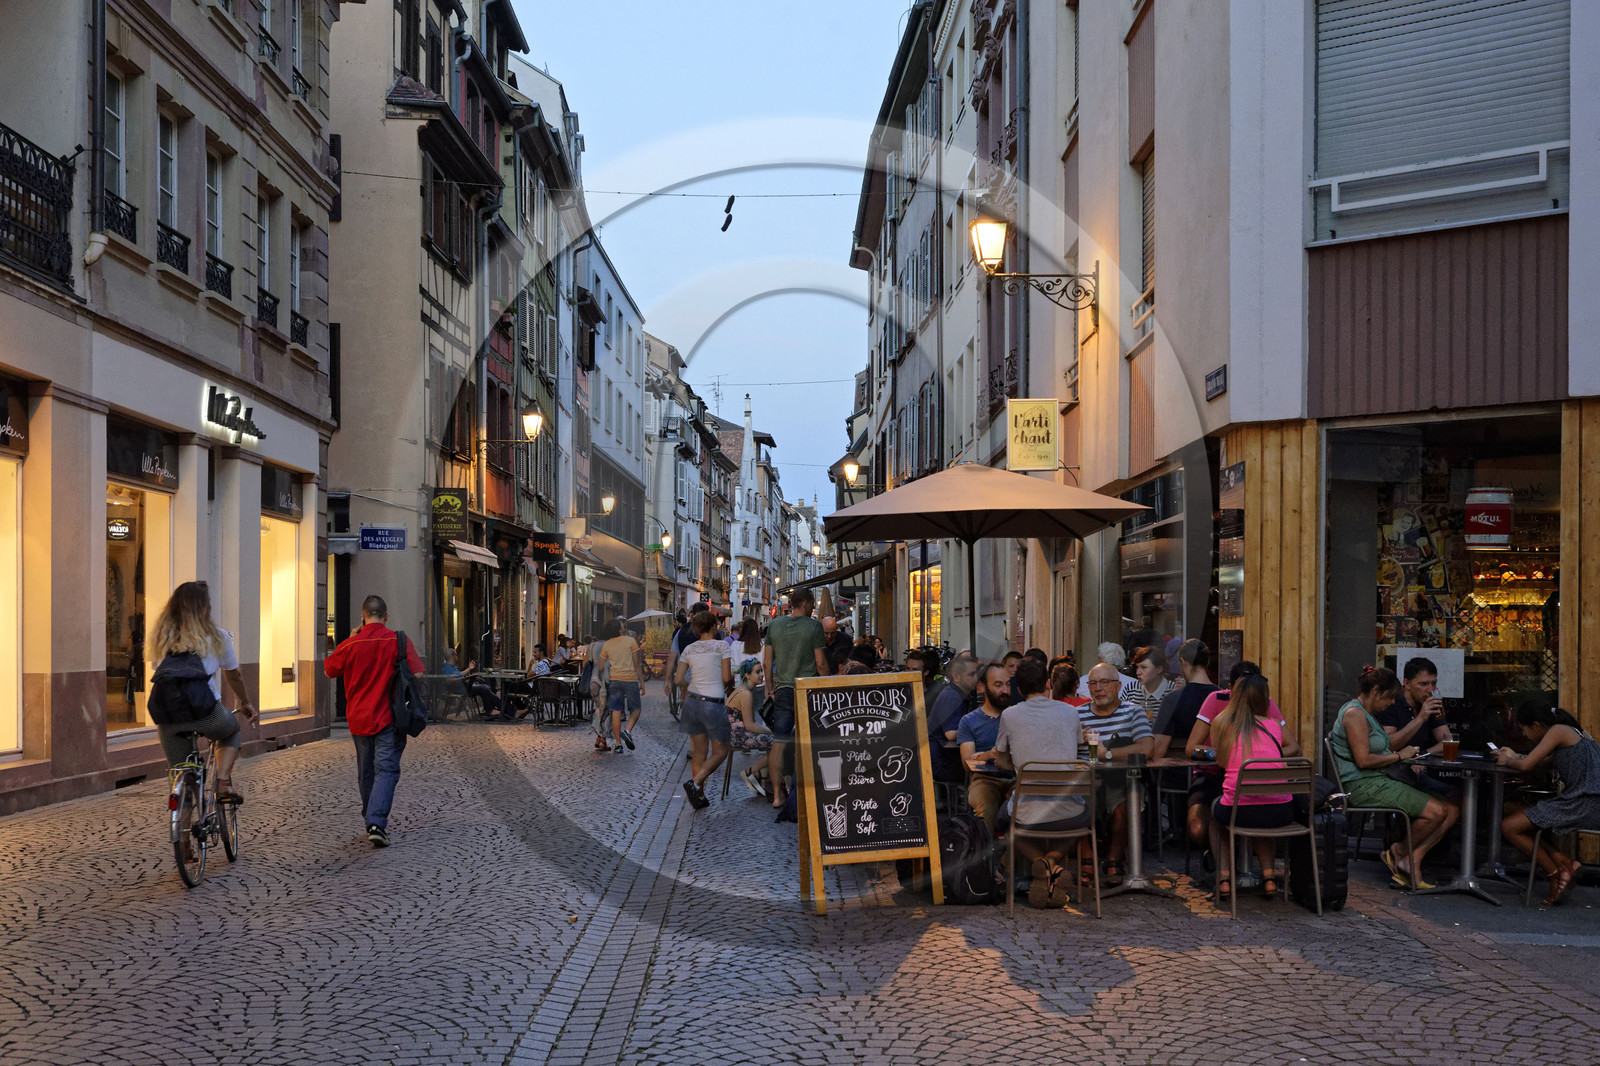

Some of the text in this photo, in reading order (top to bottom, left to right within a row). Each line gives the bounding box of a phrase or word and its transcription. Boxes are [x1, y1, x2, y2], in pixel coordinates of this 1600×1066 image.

[1014, 413, 1049, 428] l'arti
[1014, 430, 1052, 445] chaut
[1469, 514, 1501, 523] MOTUL
[534, 541, 560, 549] Speak
[812, 687, 907, 712] HAPPY HOURS
[831, 707, 890, 721] TOUS LES JOURS
[838, 720, 887, 737] 17H 20H
[846, 750, 873, 762] Pinte
[854, 762, 867, 773] de
[847, 774, 876, 785] Bière
[852, 798, 879, 811] Pinte
[860, 810, 873, 822] de
[855, 821, 878, 836] Soft
